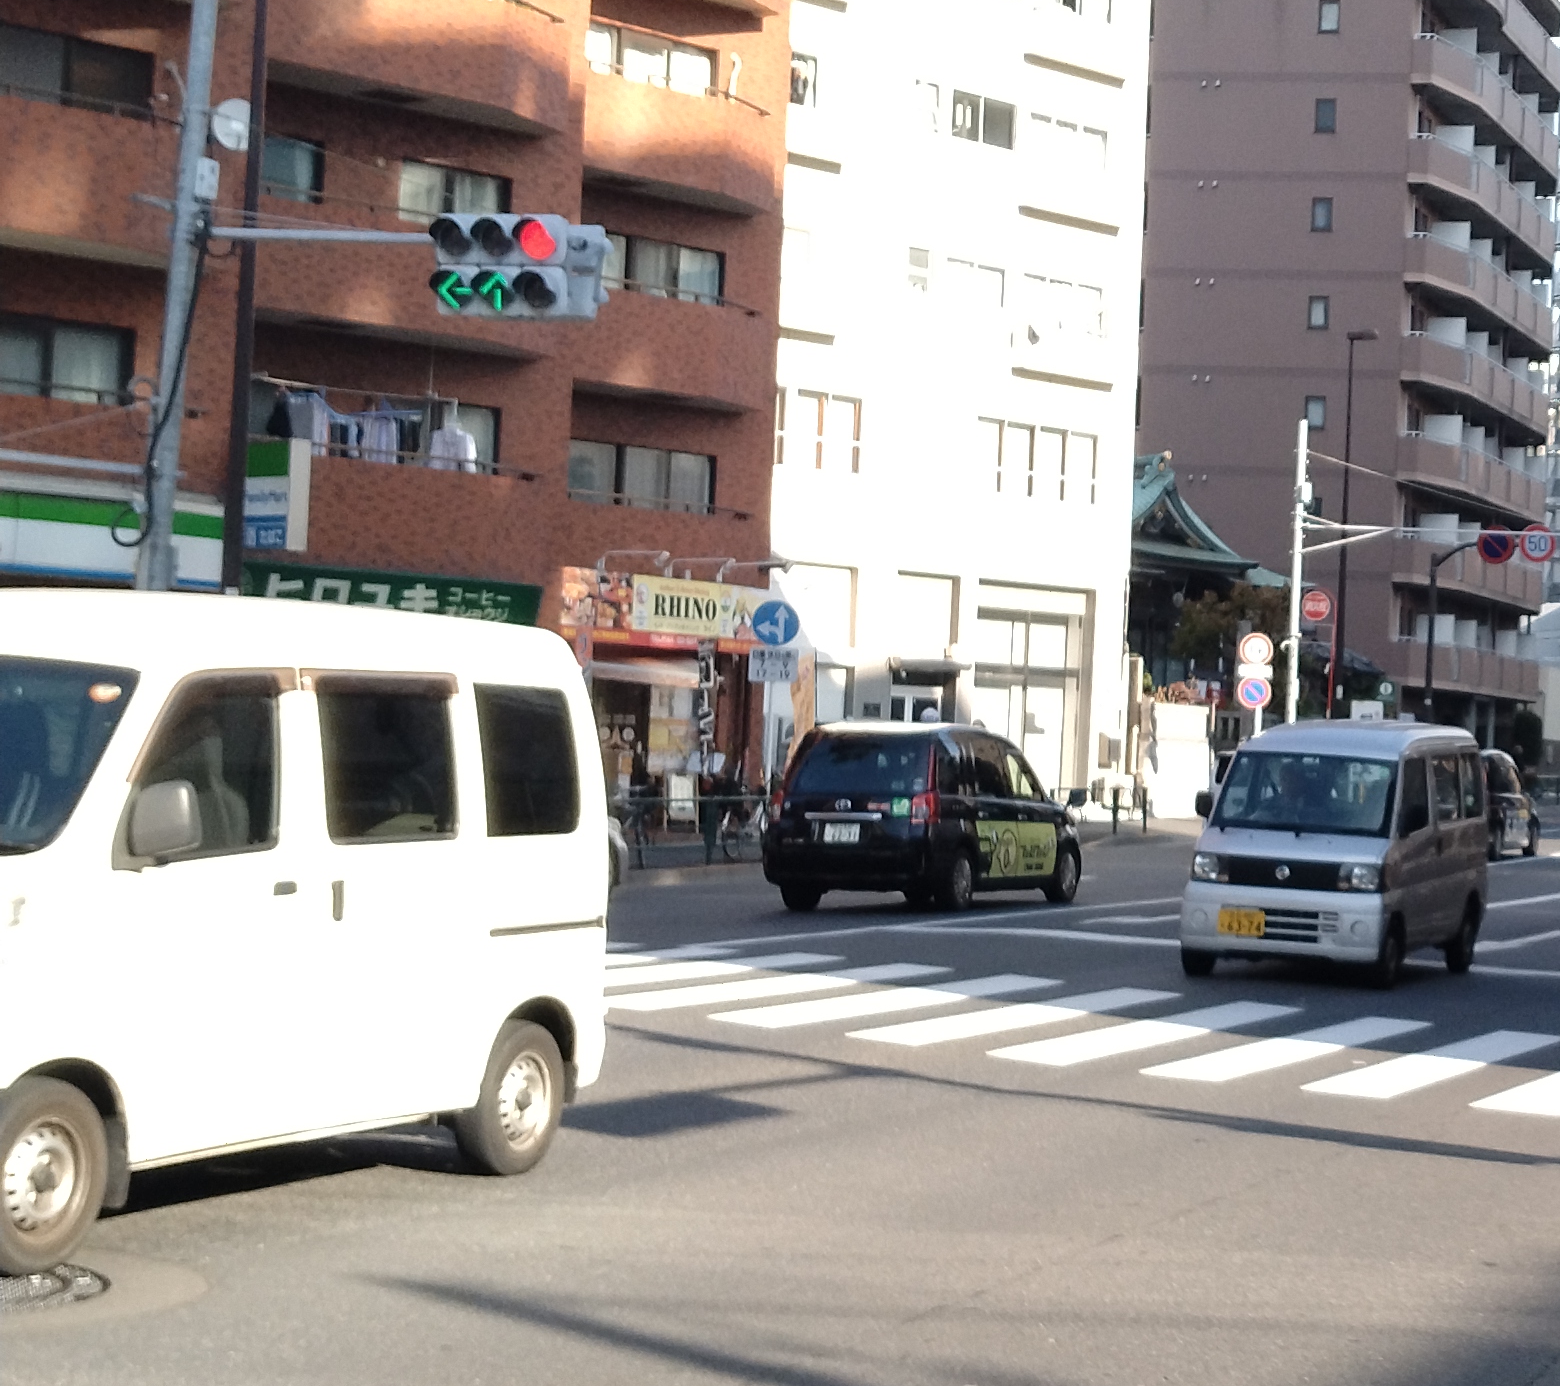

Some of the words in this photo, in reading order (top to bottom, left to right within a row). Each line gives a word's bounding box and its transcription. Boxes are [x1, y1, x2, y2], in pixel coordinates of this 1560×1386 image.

[1528, 535, 1547, 552] 50
[446, 586, 511, 607] コーヒー
[653, 592, 718, 623] RHINO
